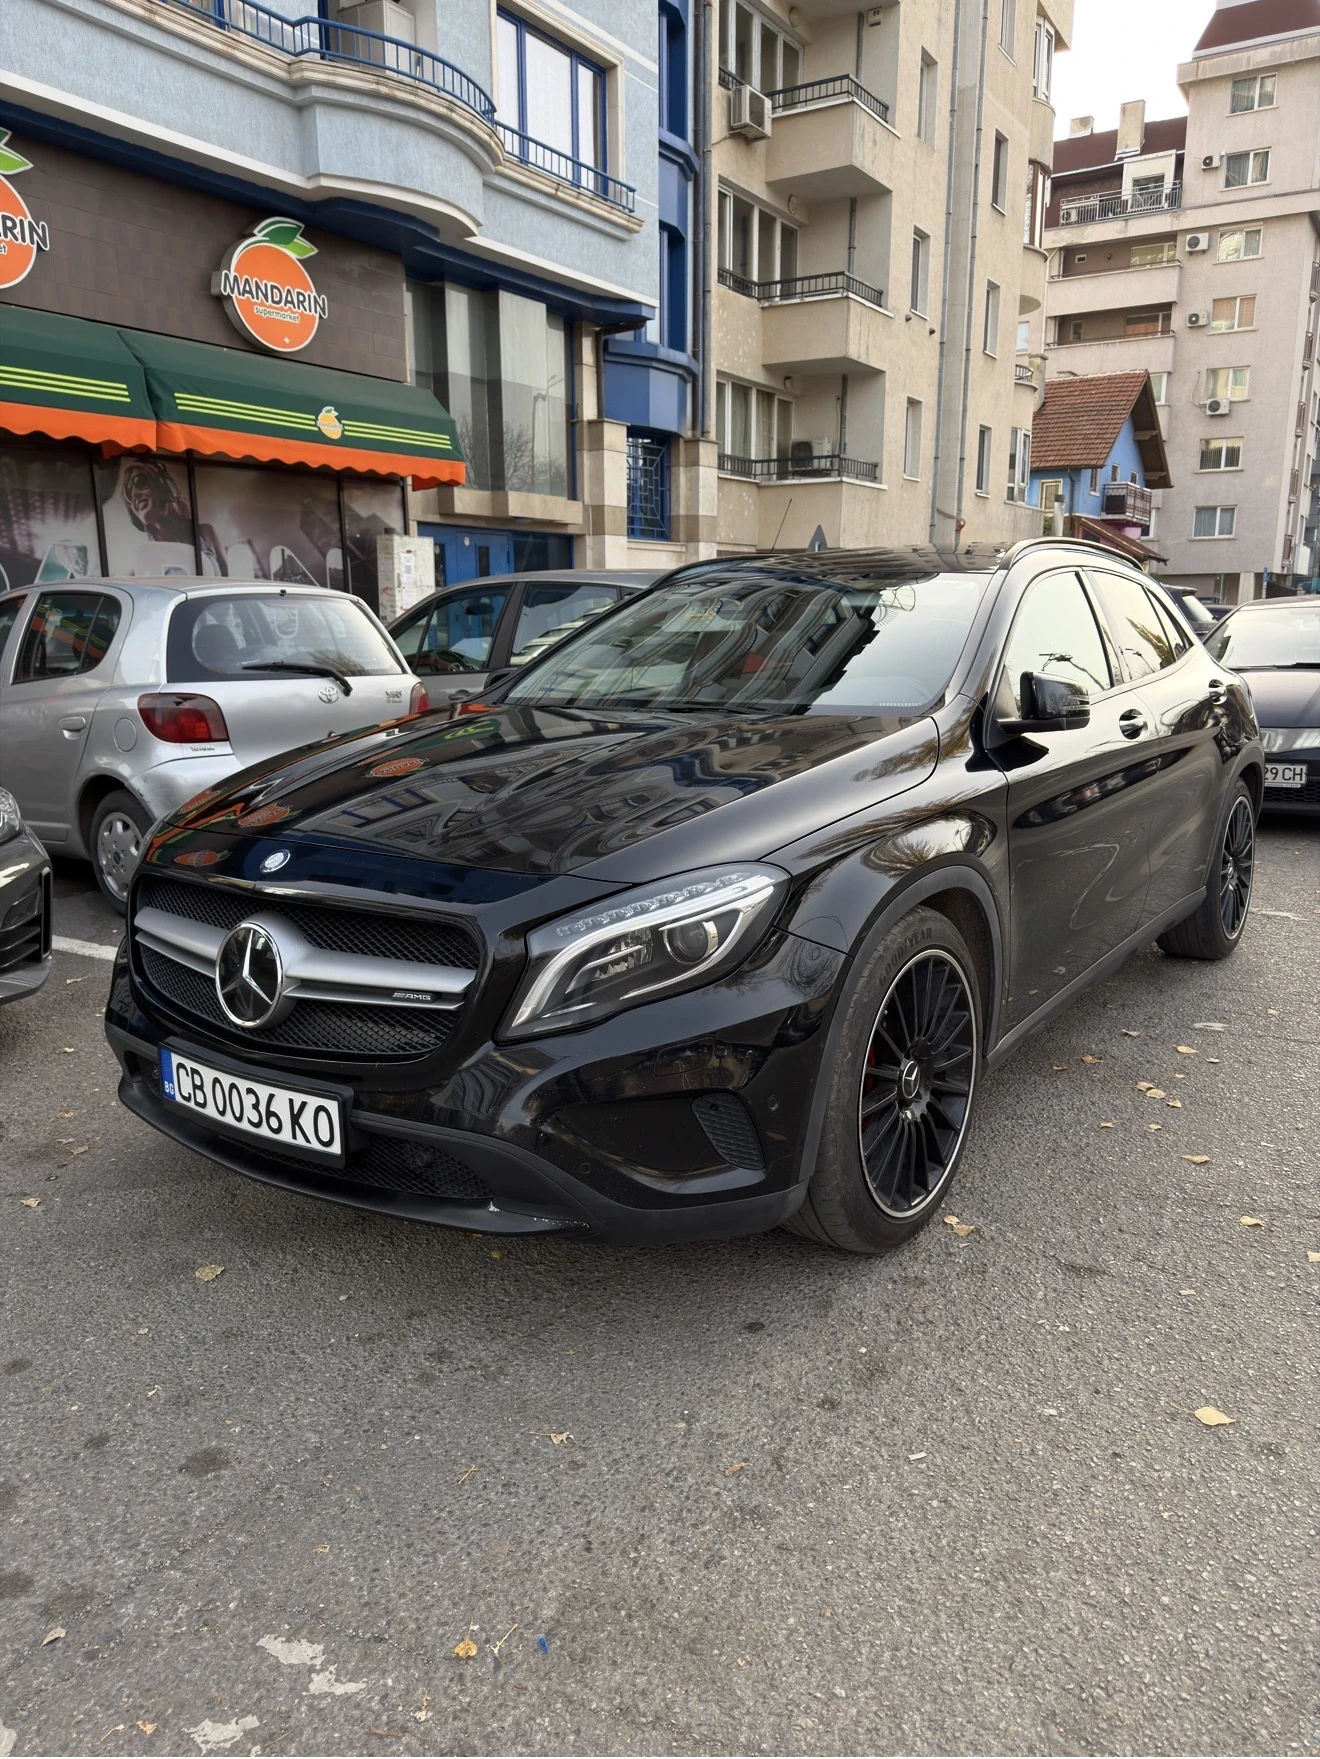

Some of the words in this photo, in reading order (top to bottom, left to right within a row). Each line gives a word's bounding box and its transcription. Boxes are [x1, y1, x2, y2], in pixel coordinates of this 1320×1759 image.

[0, 213, 49, 250] RIN
[221, 271, 327, 318] MANDARIN
[255, 306, 299, 322] supermarket
[1282, 767, 1303, 781] CH
[879, 927, 932, 987] GOODYEAR
[164, 1080, 175, 1096] BG
